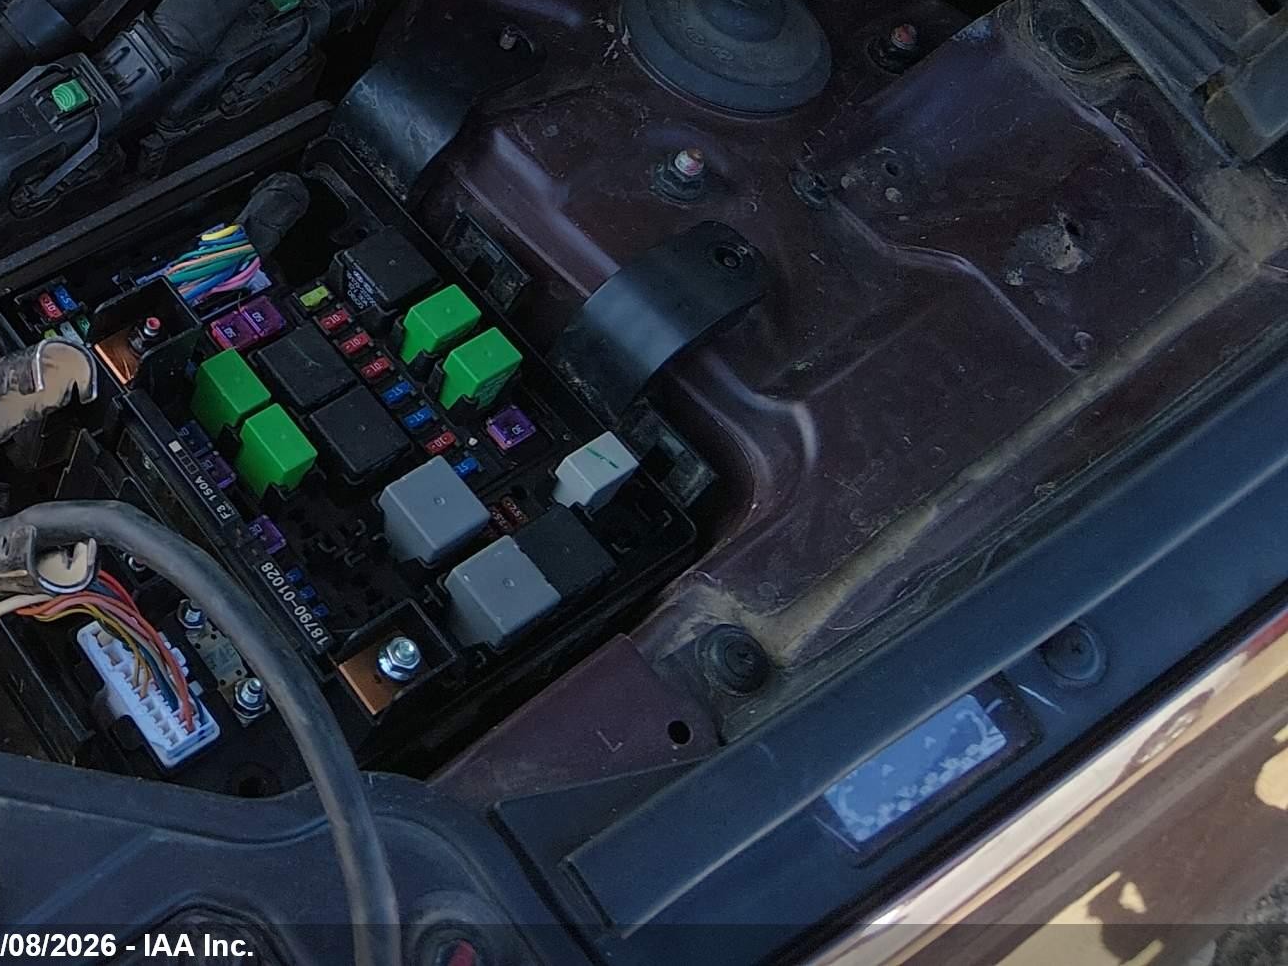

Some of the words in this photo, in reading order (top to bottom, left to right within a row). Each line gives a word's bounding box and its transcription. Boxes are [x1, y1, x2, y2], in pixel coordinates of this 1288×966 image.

[194, 475, 218, 502] 150A
[215, 504, 232, 520] F3
[259, 560, 330, 646] 18790-01028
